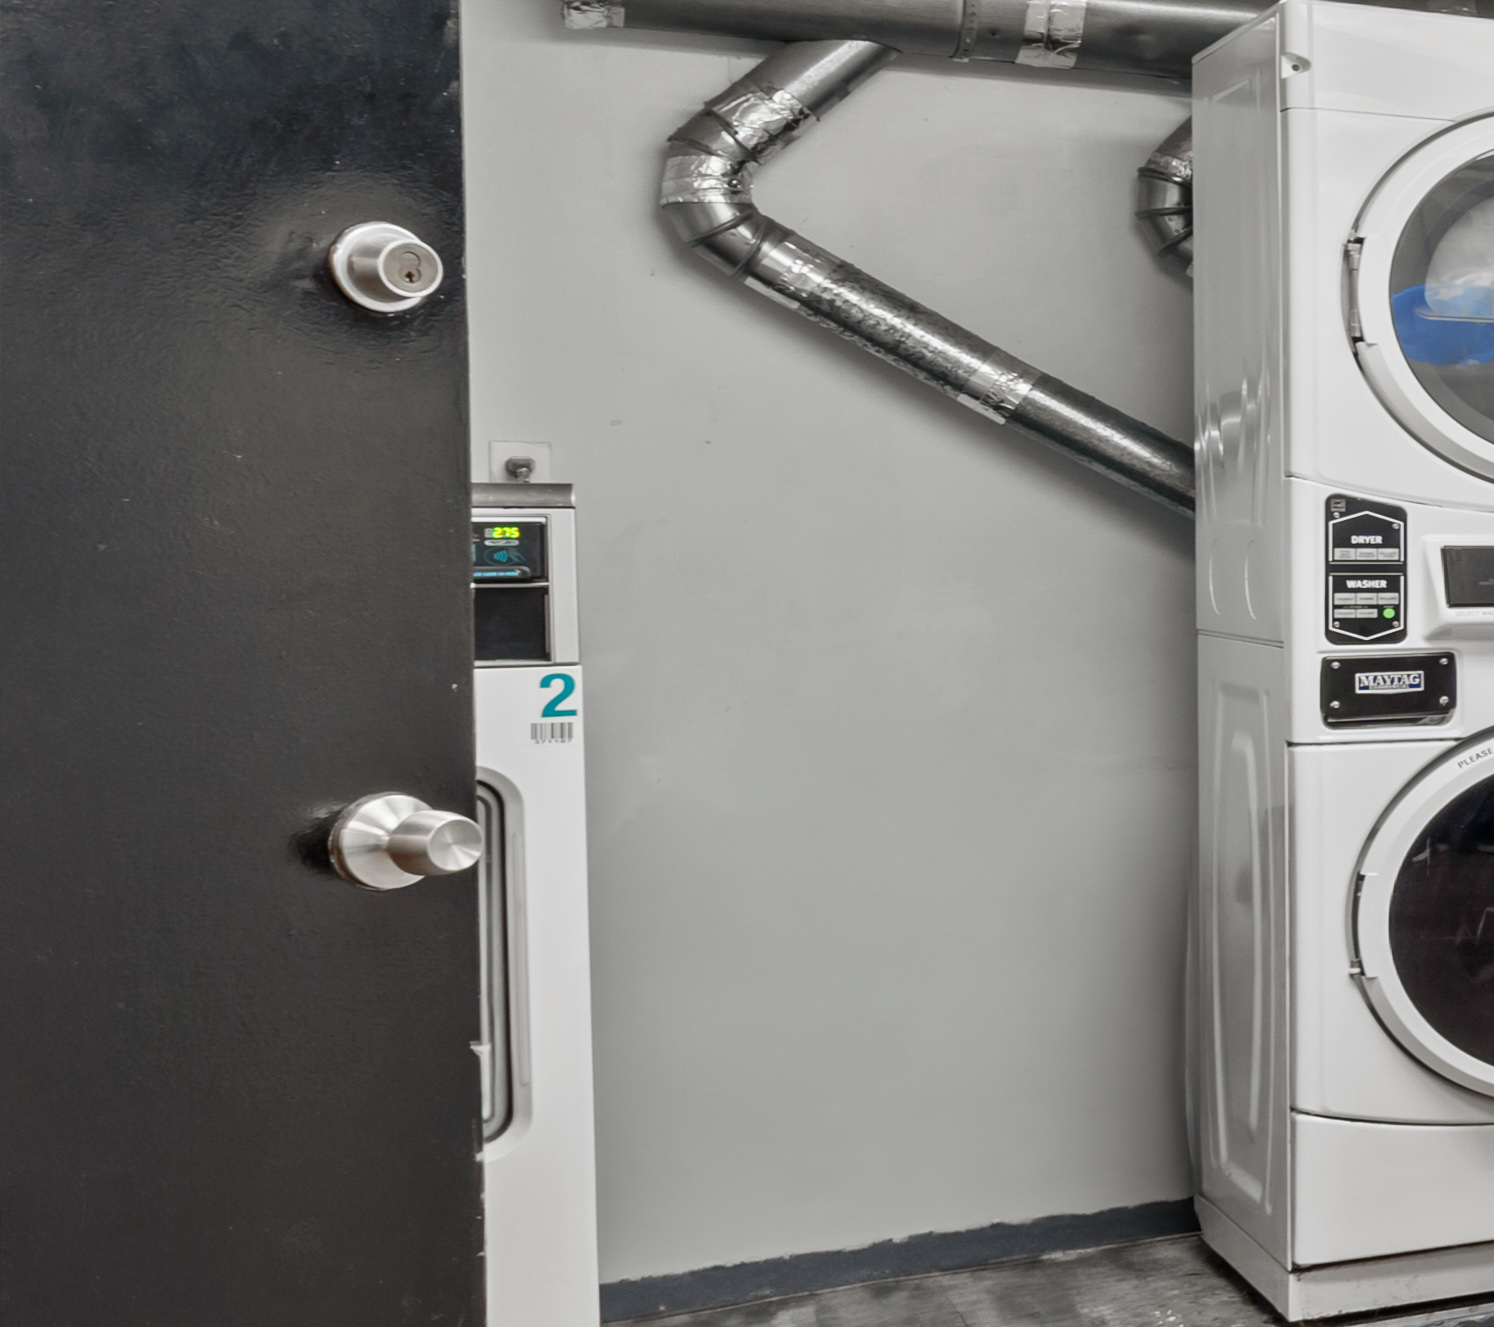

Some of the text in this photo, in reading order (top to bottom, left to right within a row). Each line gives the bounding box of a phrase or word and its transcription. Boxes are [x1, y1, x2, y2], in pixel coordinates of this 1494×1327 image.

[1351, 535, 1383, 544] DRYER
[1346, 580, 1387, 588] WASHER
[1359, 673, 1420, 687] MAYTAG
[539, 673, 578, 718] 2
[1457, 747, 1494, 769] PLEASE
